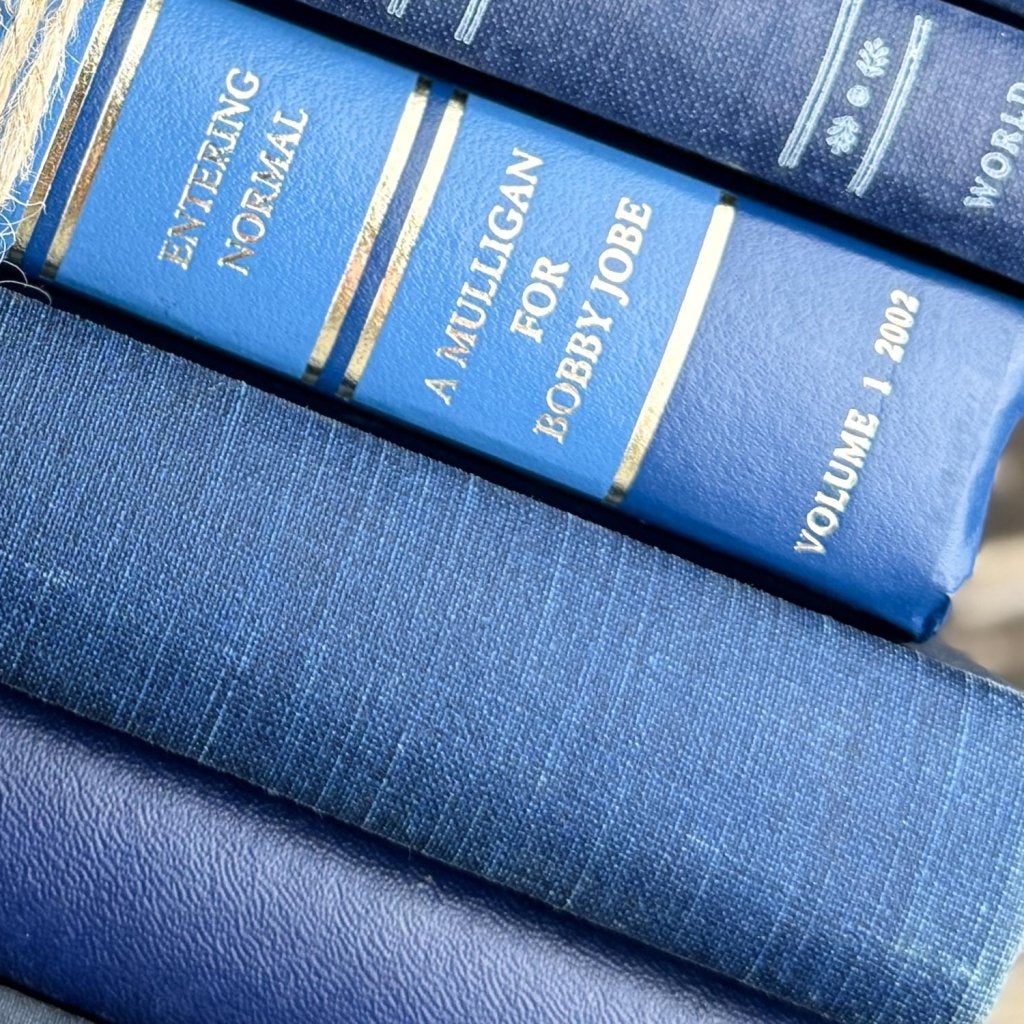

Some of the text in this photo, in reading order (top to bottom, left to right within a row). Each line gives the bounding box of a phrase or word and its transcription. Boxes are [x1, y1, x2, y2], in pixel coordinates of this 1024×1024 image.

[156, 66, 261, 272] ENTERING
[217, 108, 309, 277] NORMAL
[424, 146, 544, 406] A MULLIGAN
[510, 255, 571, 344] FOR
[532, 195, 653, 446] BOBBY JOBE
[793, 287, 922, 556] VOLUME 1 2002
